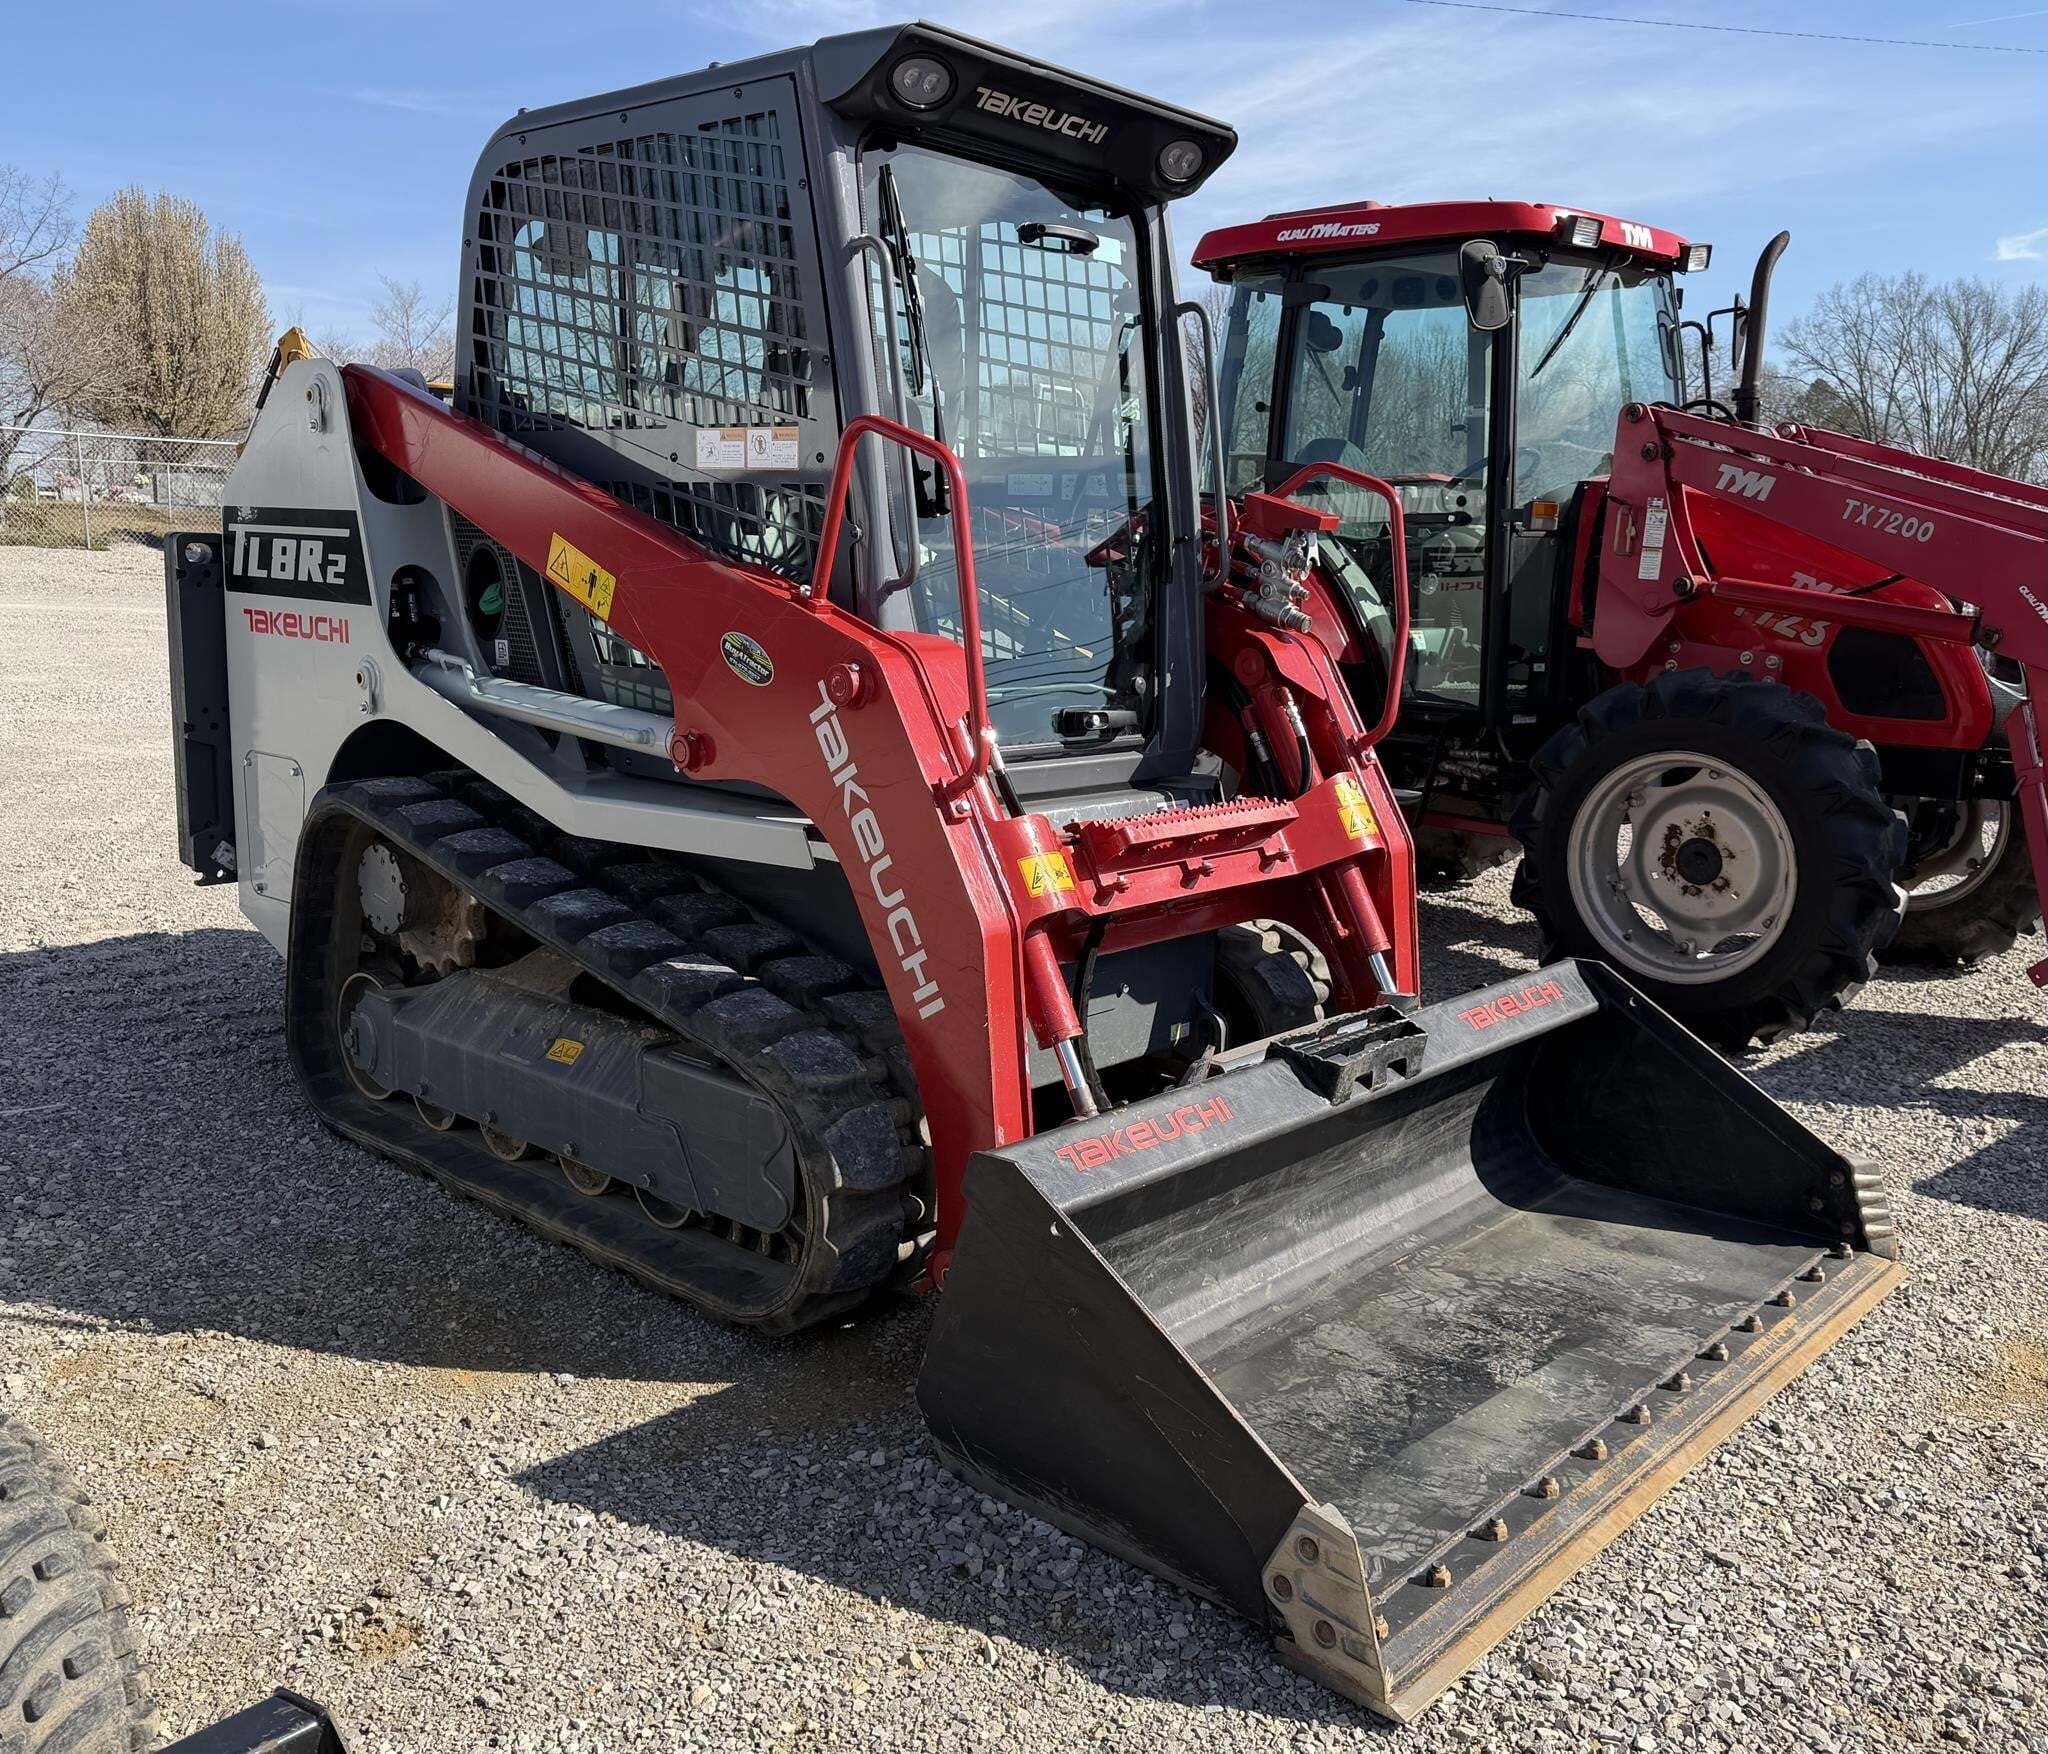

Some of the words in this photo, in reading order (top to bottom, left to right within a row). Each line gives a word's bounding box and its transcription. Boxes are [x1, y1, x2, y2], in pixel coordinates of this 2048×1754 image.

[1620, 222, 1654, 249] TYM
[1716, 463, 1776, 501] TYM
[1842, 498, 1935, 542] TX7200
[228, 523, 350, 585] TL8R2
